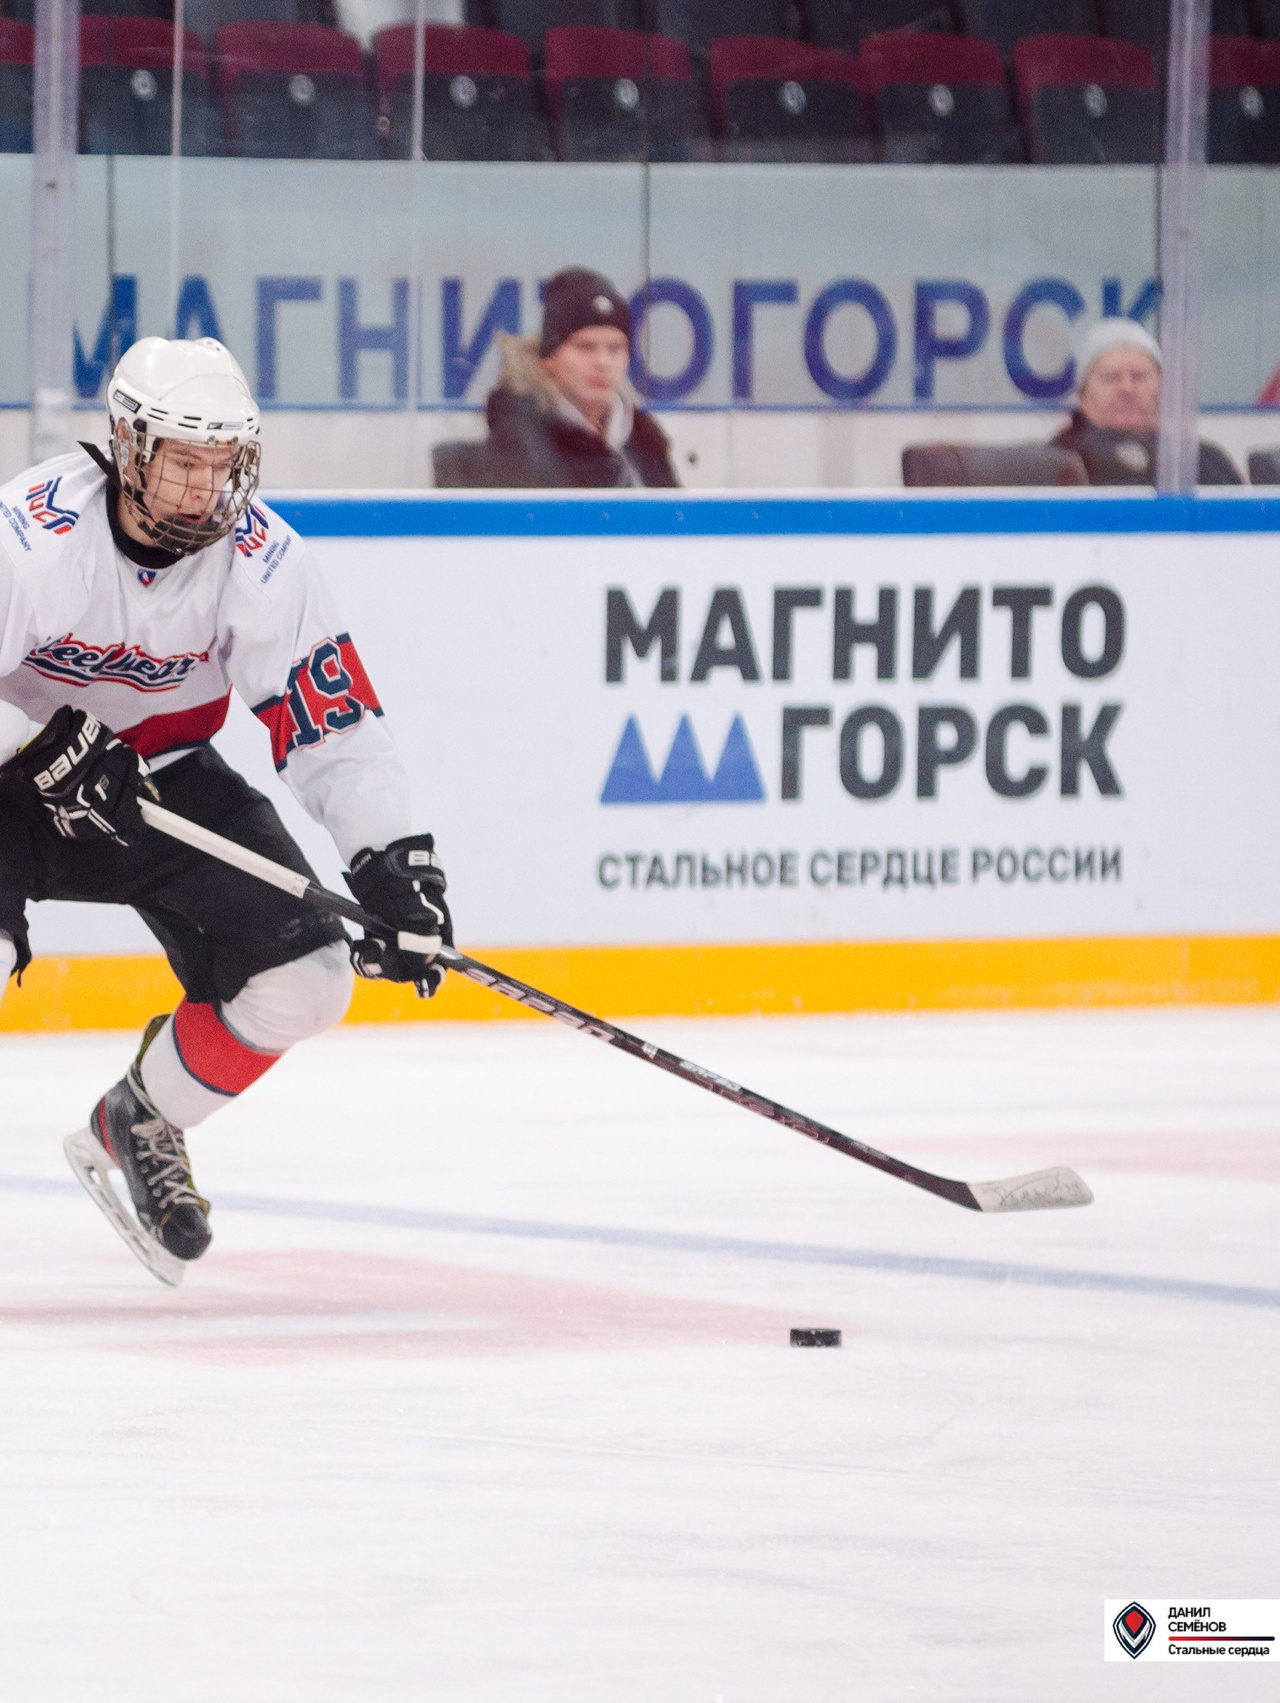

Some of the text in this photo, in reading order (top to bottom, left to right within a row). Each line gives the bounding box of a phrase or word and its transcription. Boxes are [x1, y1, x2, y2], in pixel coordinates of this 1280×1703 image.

[260, 559, 280, 584] UNITED
[604, 584, 1128, 682] МАГНИТО
[287, 637, 366, 750] 19
[33, 712, 101, 791] BAUE
[780, 703, 1125, 801] ГОРСК
[598, 848, 1123, 891] СТАЛЬНОЕ СЕРДЦЕ РОССИИ
